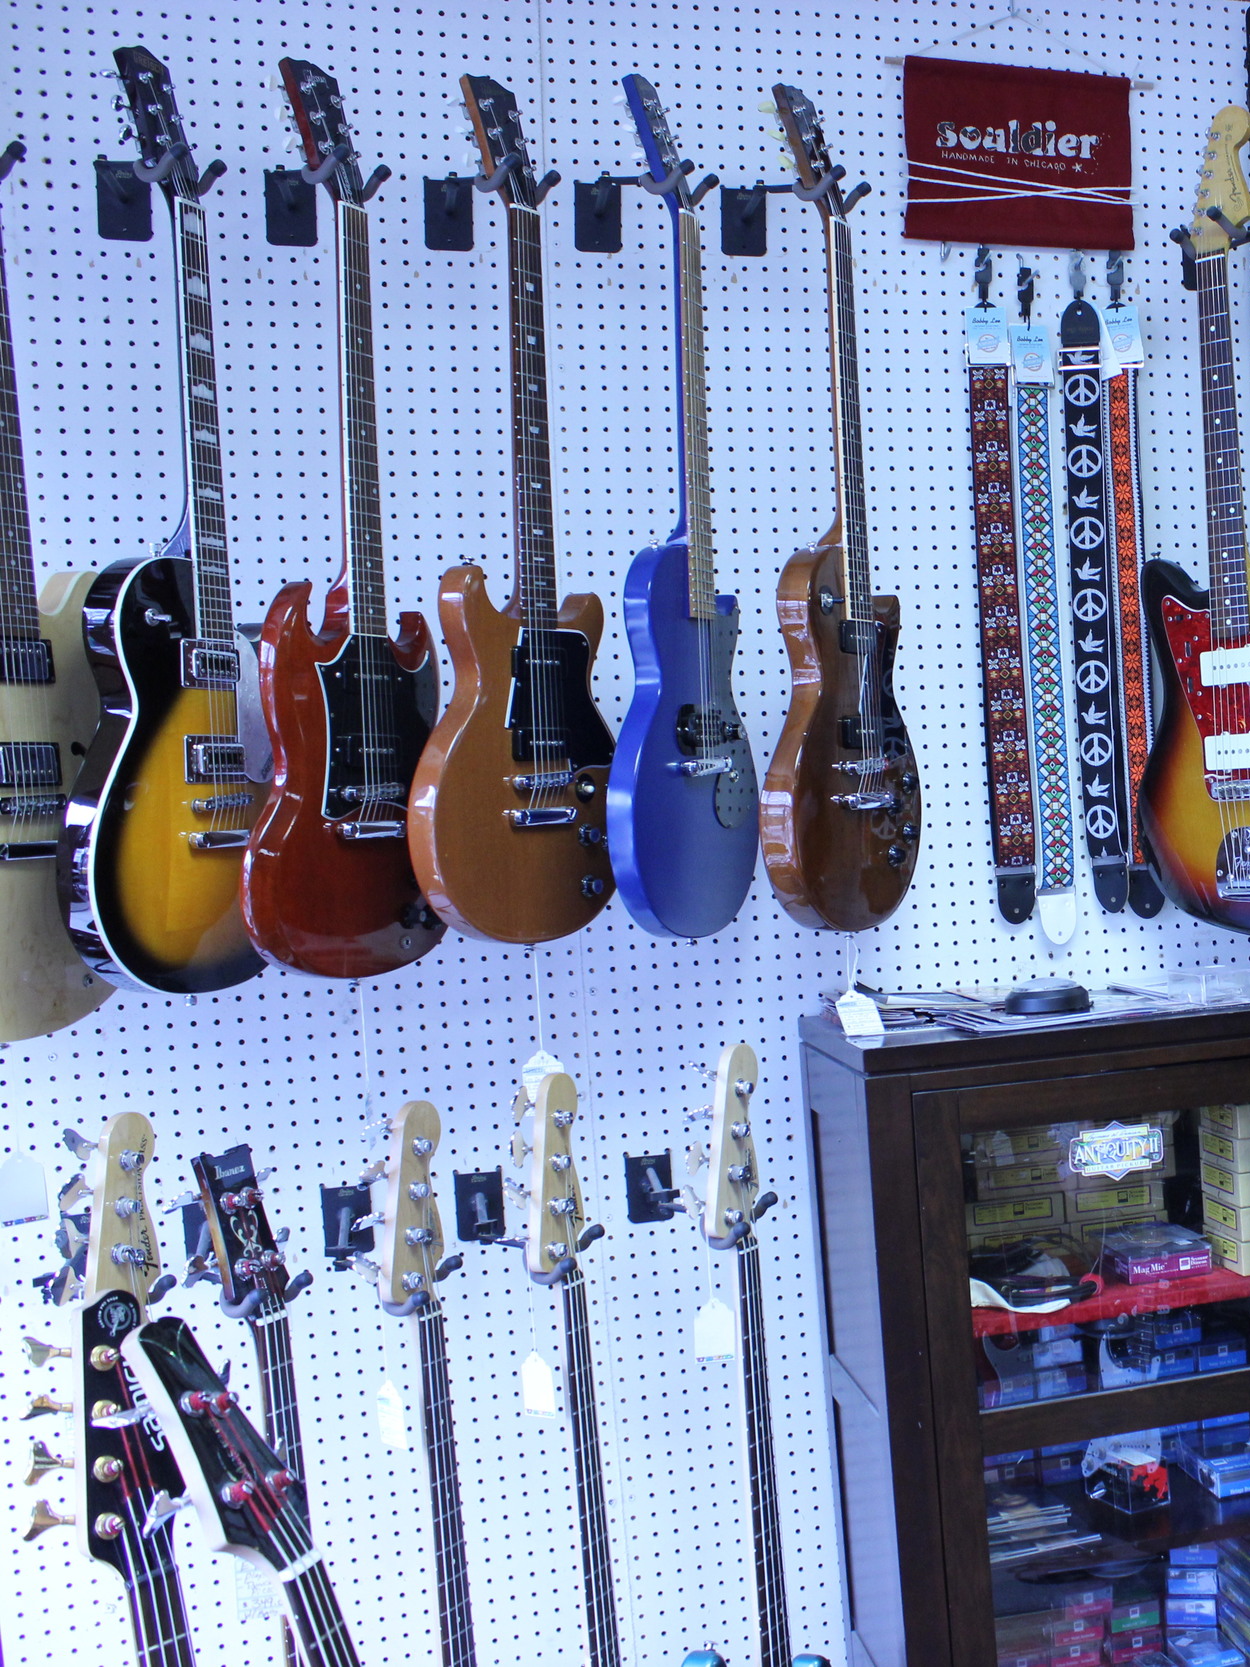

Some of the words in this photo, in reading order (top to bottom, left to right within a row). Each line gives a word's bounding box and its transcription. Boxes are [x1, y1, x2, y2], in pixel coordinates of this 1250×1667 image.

[936, 119, 1099, 159] Souldier
[941, 150, 995, 164] HANDMADE
[1006, 156, 1018, 166] IN
[1024, 159, 1066, 174] CHICAGO
[972, 317, 990, 325] Bobby
[1016, 335, 1032, 343] Bobby
[1074, 1138, 1147, 1164] ANTIQUITY
[1149, 1137, 1158, 1152] II
[214, 1164, 245, 1180] Ibanez
[1086, 1163, 1114, 1172] GUITAR
[1116, 1160, 1148, 1168] PICKUPS
[139, 1225, 158, 1277] Fender
[1191, 1255, 1209, 1263] Seymour
[1133, 1265, 1150, 1275] Mag
[1151, 1263, 1166, 1272] Mic
